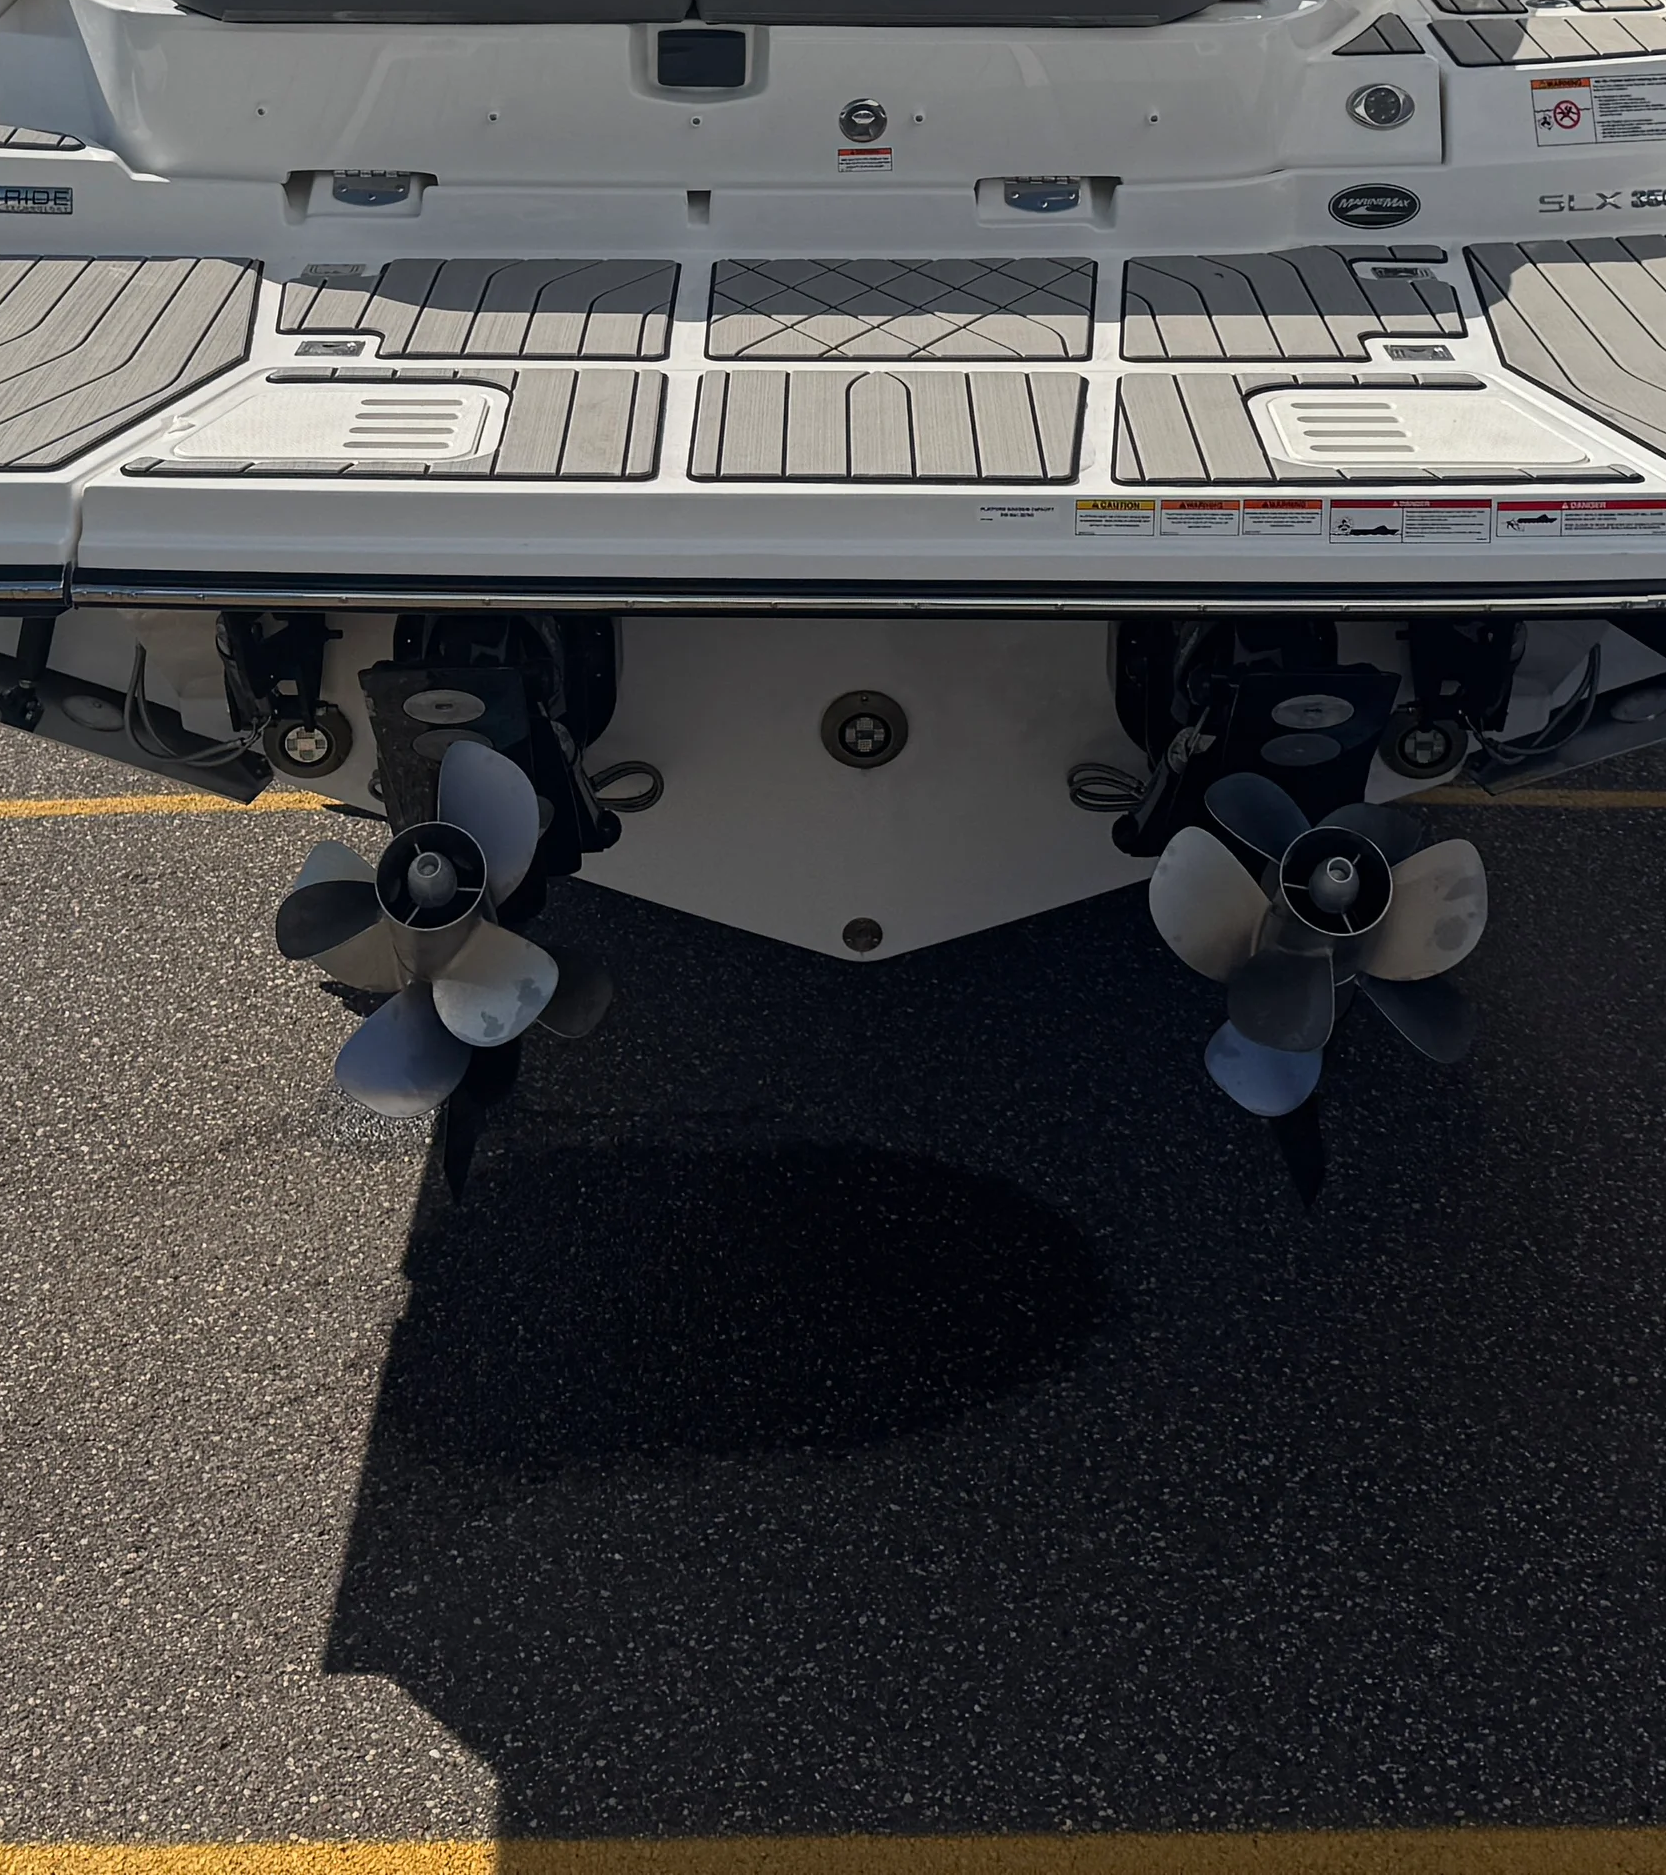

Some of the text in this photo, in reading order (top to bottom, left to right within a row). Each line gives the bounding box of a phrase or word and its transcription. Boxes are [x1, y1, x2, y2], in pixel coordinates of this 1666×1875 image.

[1539, 192, 1622, 213] SLX
[1100, 500, 1141, 511] CAUTION
[1570, 501, 1607, 509] DANGER
